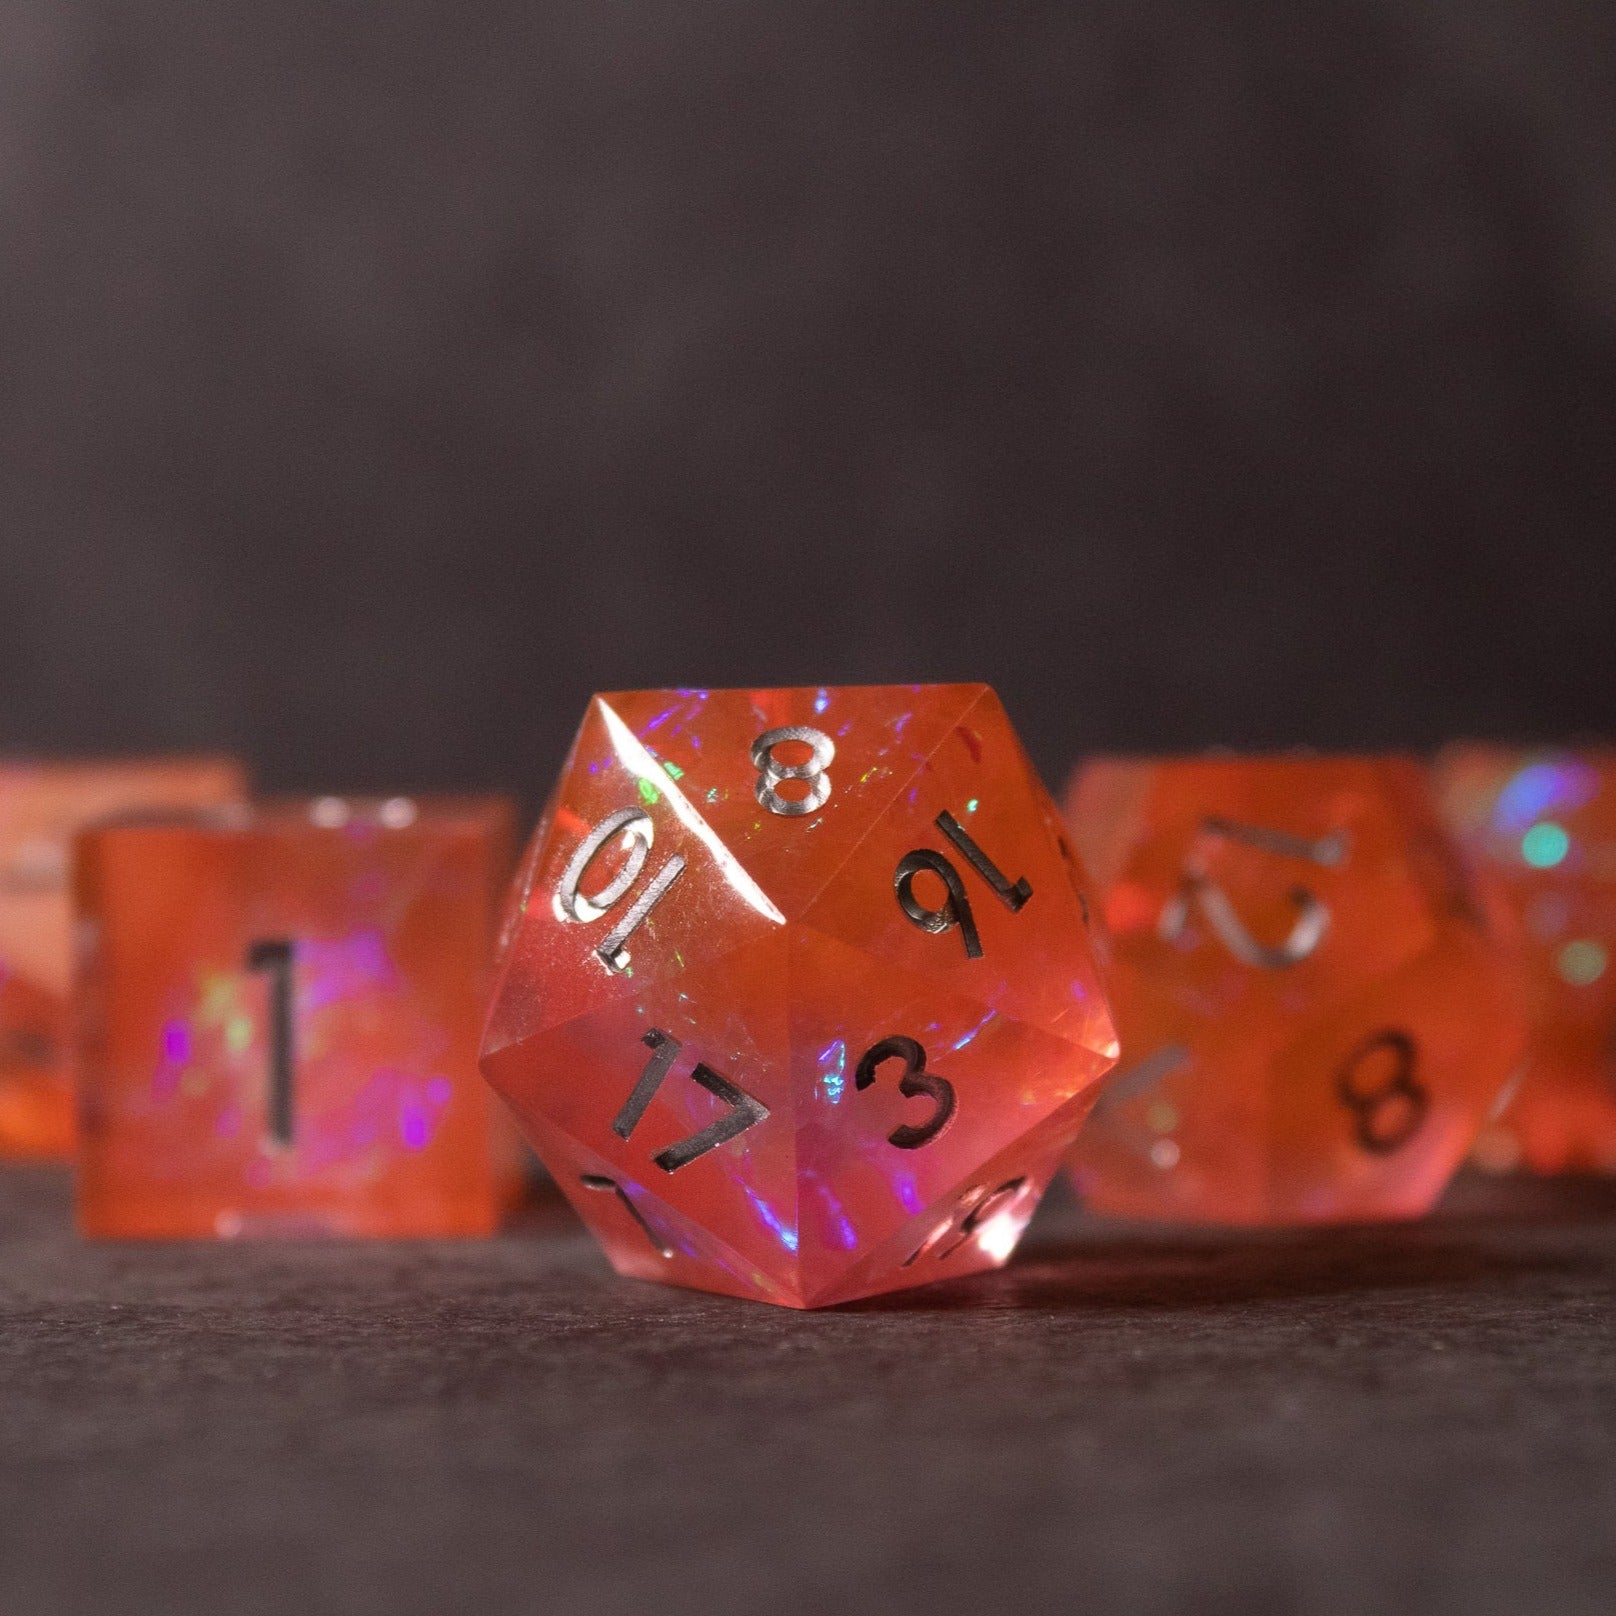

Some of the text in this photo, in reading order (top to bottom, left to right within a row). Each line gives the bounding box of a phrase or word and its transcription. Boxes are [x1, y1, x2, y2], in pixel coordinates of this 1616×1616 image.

[751, 727, 835, 816] 8
[553, 806, 686, 975] 10
[894, 809, 1034, 959] 16
[246, 938, 294, 1146] 1
[612, 1027, 770, 1174] 17
[855, 1035, 957, 1150] 3
[1335, 1030, 1430, 1156] 8
